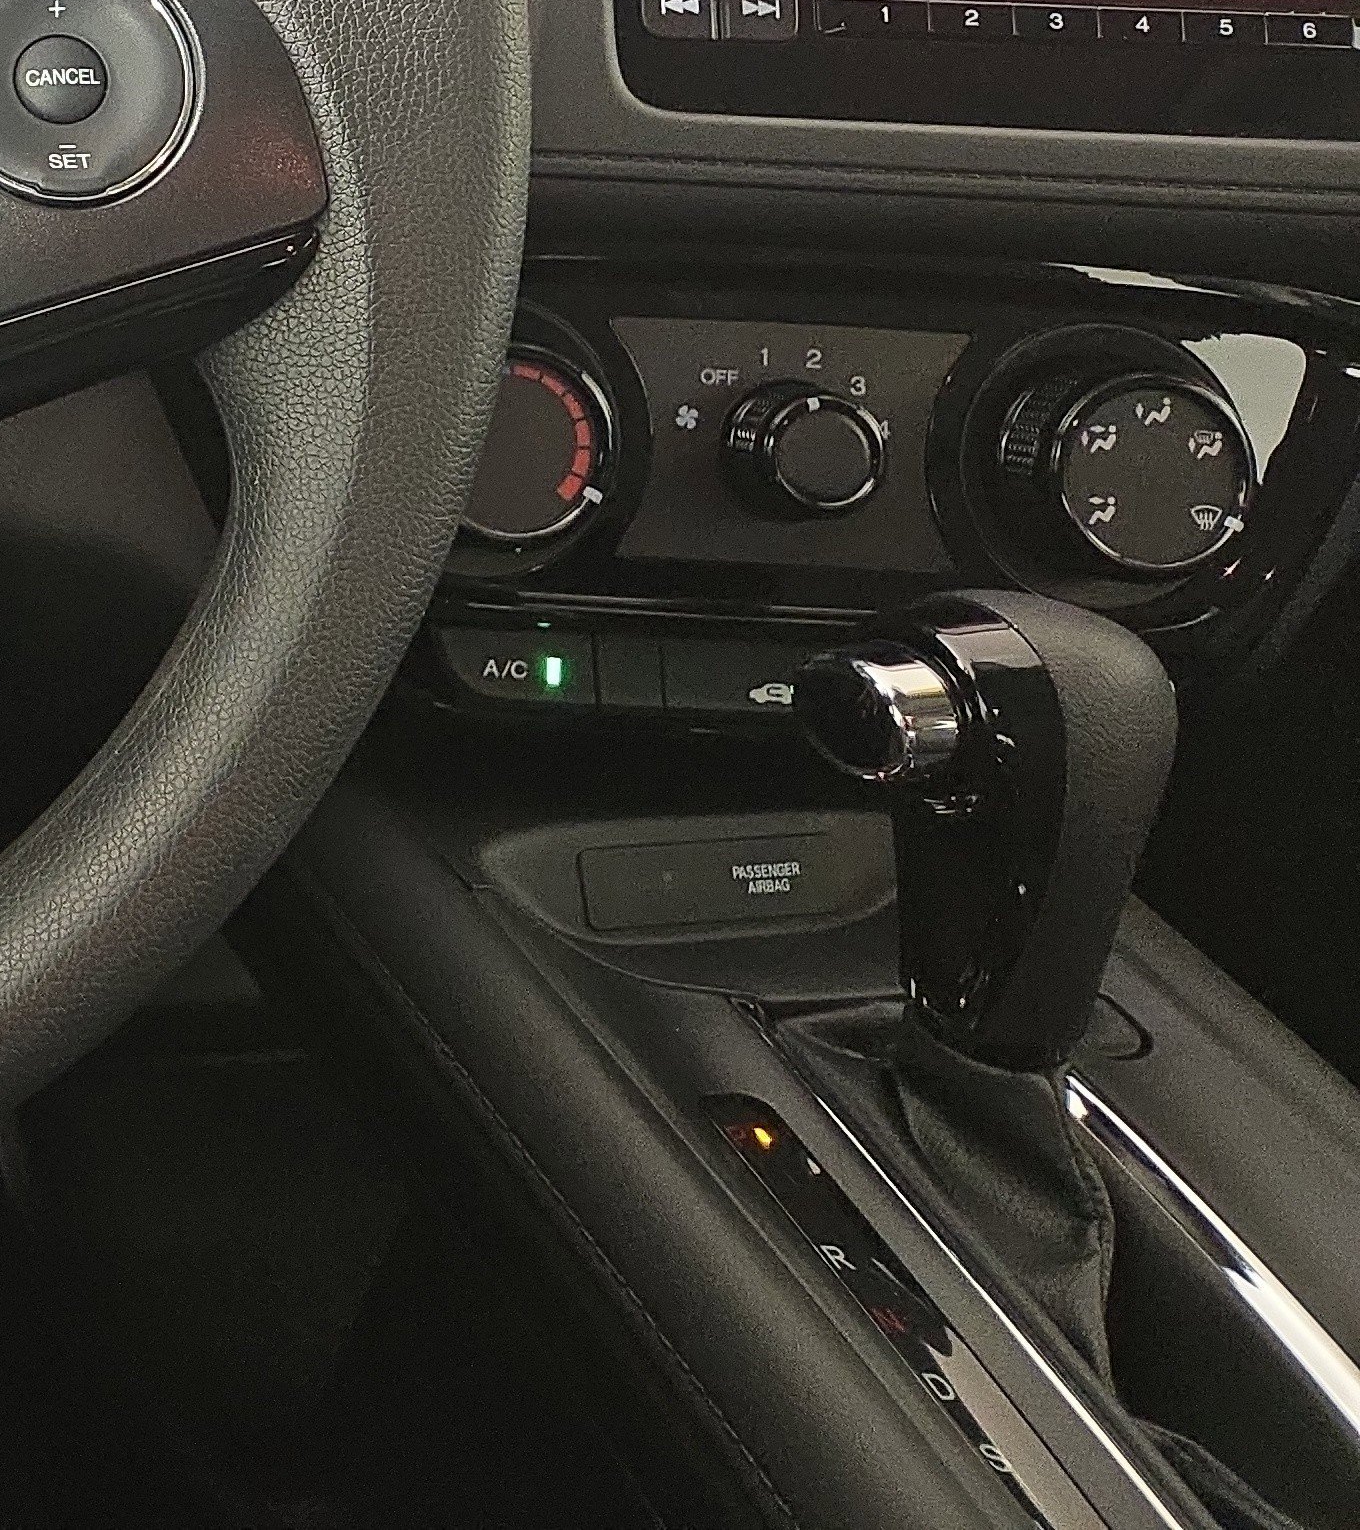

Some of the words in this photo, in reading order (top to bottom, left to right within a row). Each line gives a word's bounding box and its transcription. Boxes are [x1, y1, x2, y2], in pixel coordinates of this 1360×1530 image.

[881, 6, 890, 23] 1
[964, 9, 980, 26] 2
[1048, 12, 1064, 30] 3
[1135, 15, 1150, 33] 4
[1219, 18, 1234, 36] 5
[1303, 22, 1317, 39] 6
[25, 68, 101, 86] CANCEL
[48, 153, 91, 169] SET
[761, 348, 769, 367] 1
[806, 348, 822, 369] 2
[700, 369, 739, 385] OFF
[850, 376, 866, 396] 3
[483, 659, 528, 678] A/C
[732, 862, 800, 879] PASSENGER
[748, 878, 790, 894] AIRBAG
[820, 1245, 856, 1270] R
[921, 1373, 955, 1400] D
[980, 1444, 1012, 1472] S
